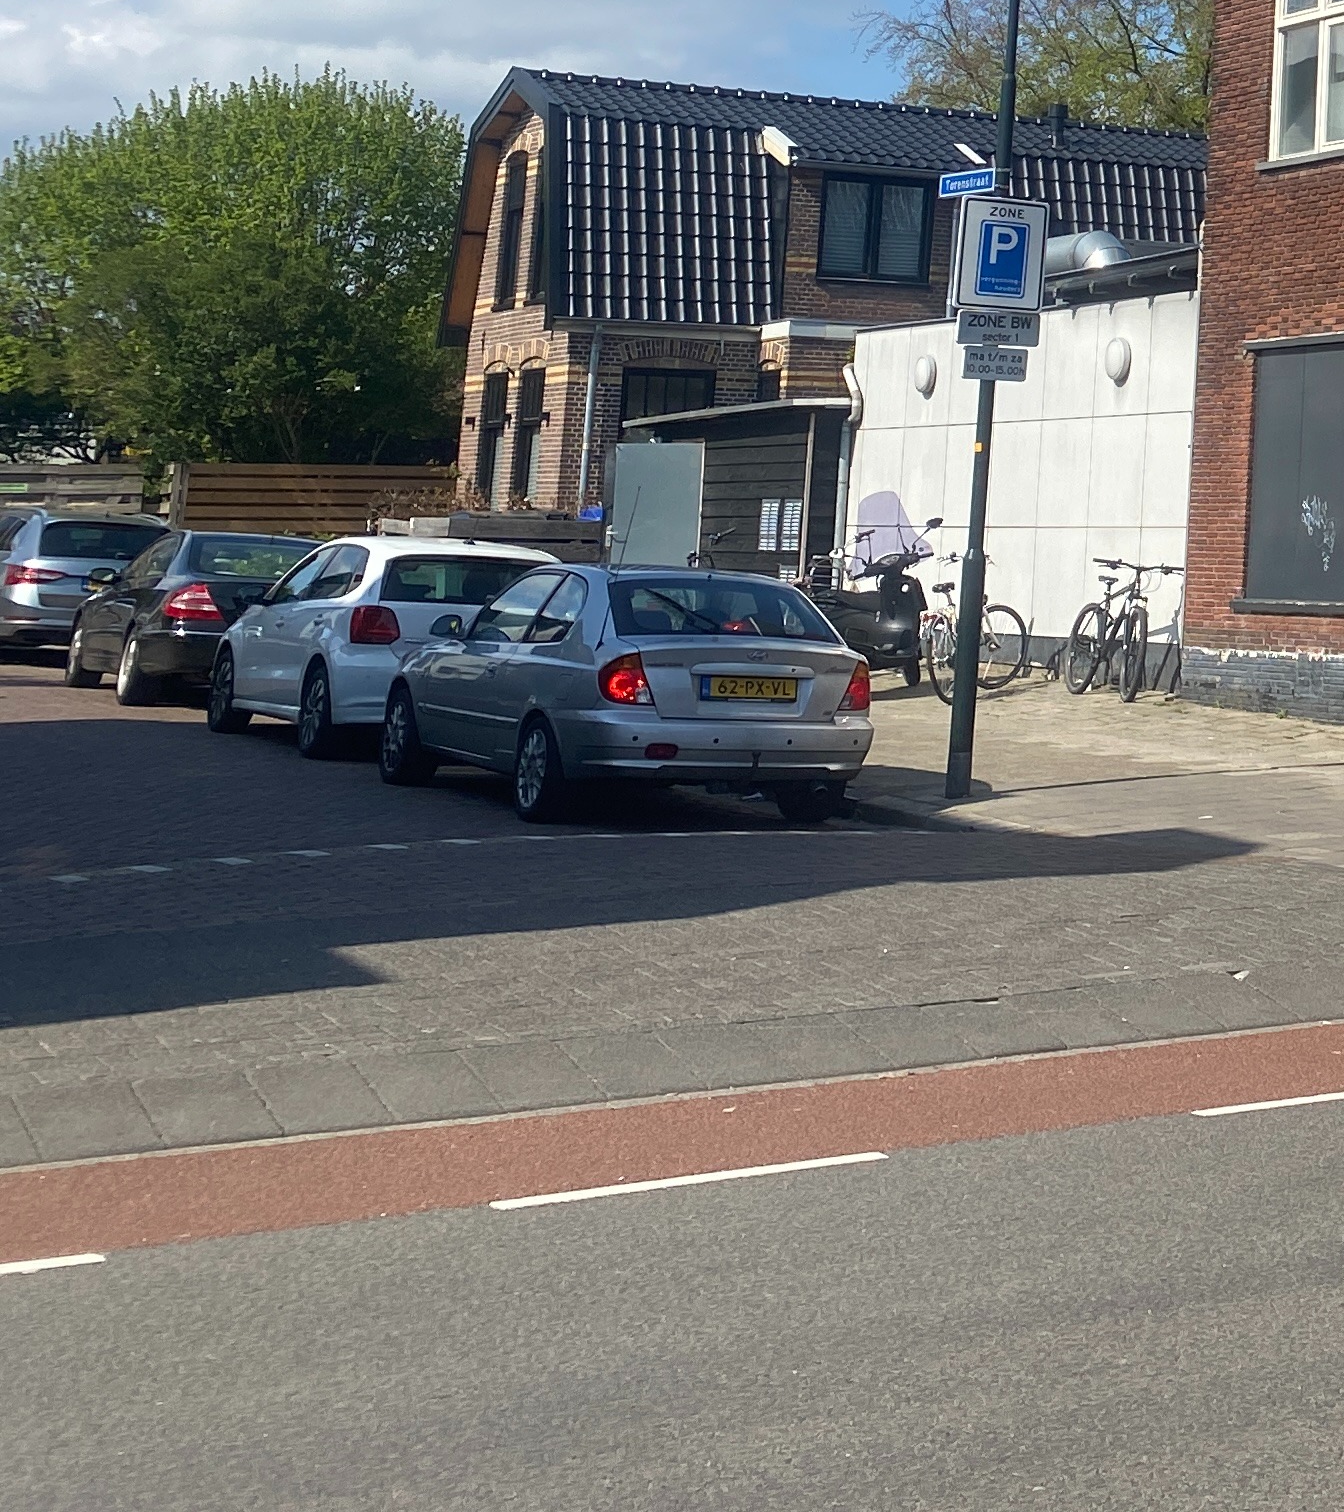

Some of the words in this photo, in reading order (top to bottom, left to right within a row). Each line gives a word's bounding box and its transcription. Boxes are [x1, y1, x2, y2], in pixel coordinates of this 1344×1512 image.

[945, 174, 989, 191] Torenstraat
[989, 206, 1025, 220] ZONE
[989, 225, 1019, 265] P
[967, 314, 1007, 328] ZONE
[1011, 316, 1032, 329] BW
[982, 333, 1012, 342] sector
[969, 352, 985, 361] ma
[988, 351, 1008, 363] t/m
[1011, 355, 1023, 363] za
[717, 679, 791, 697] 62-PX-VL
